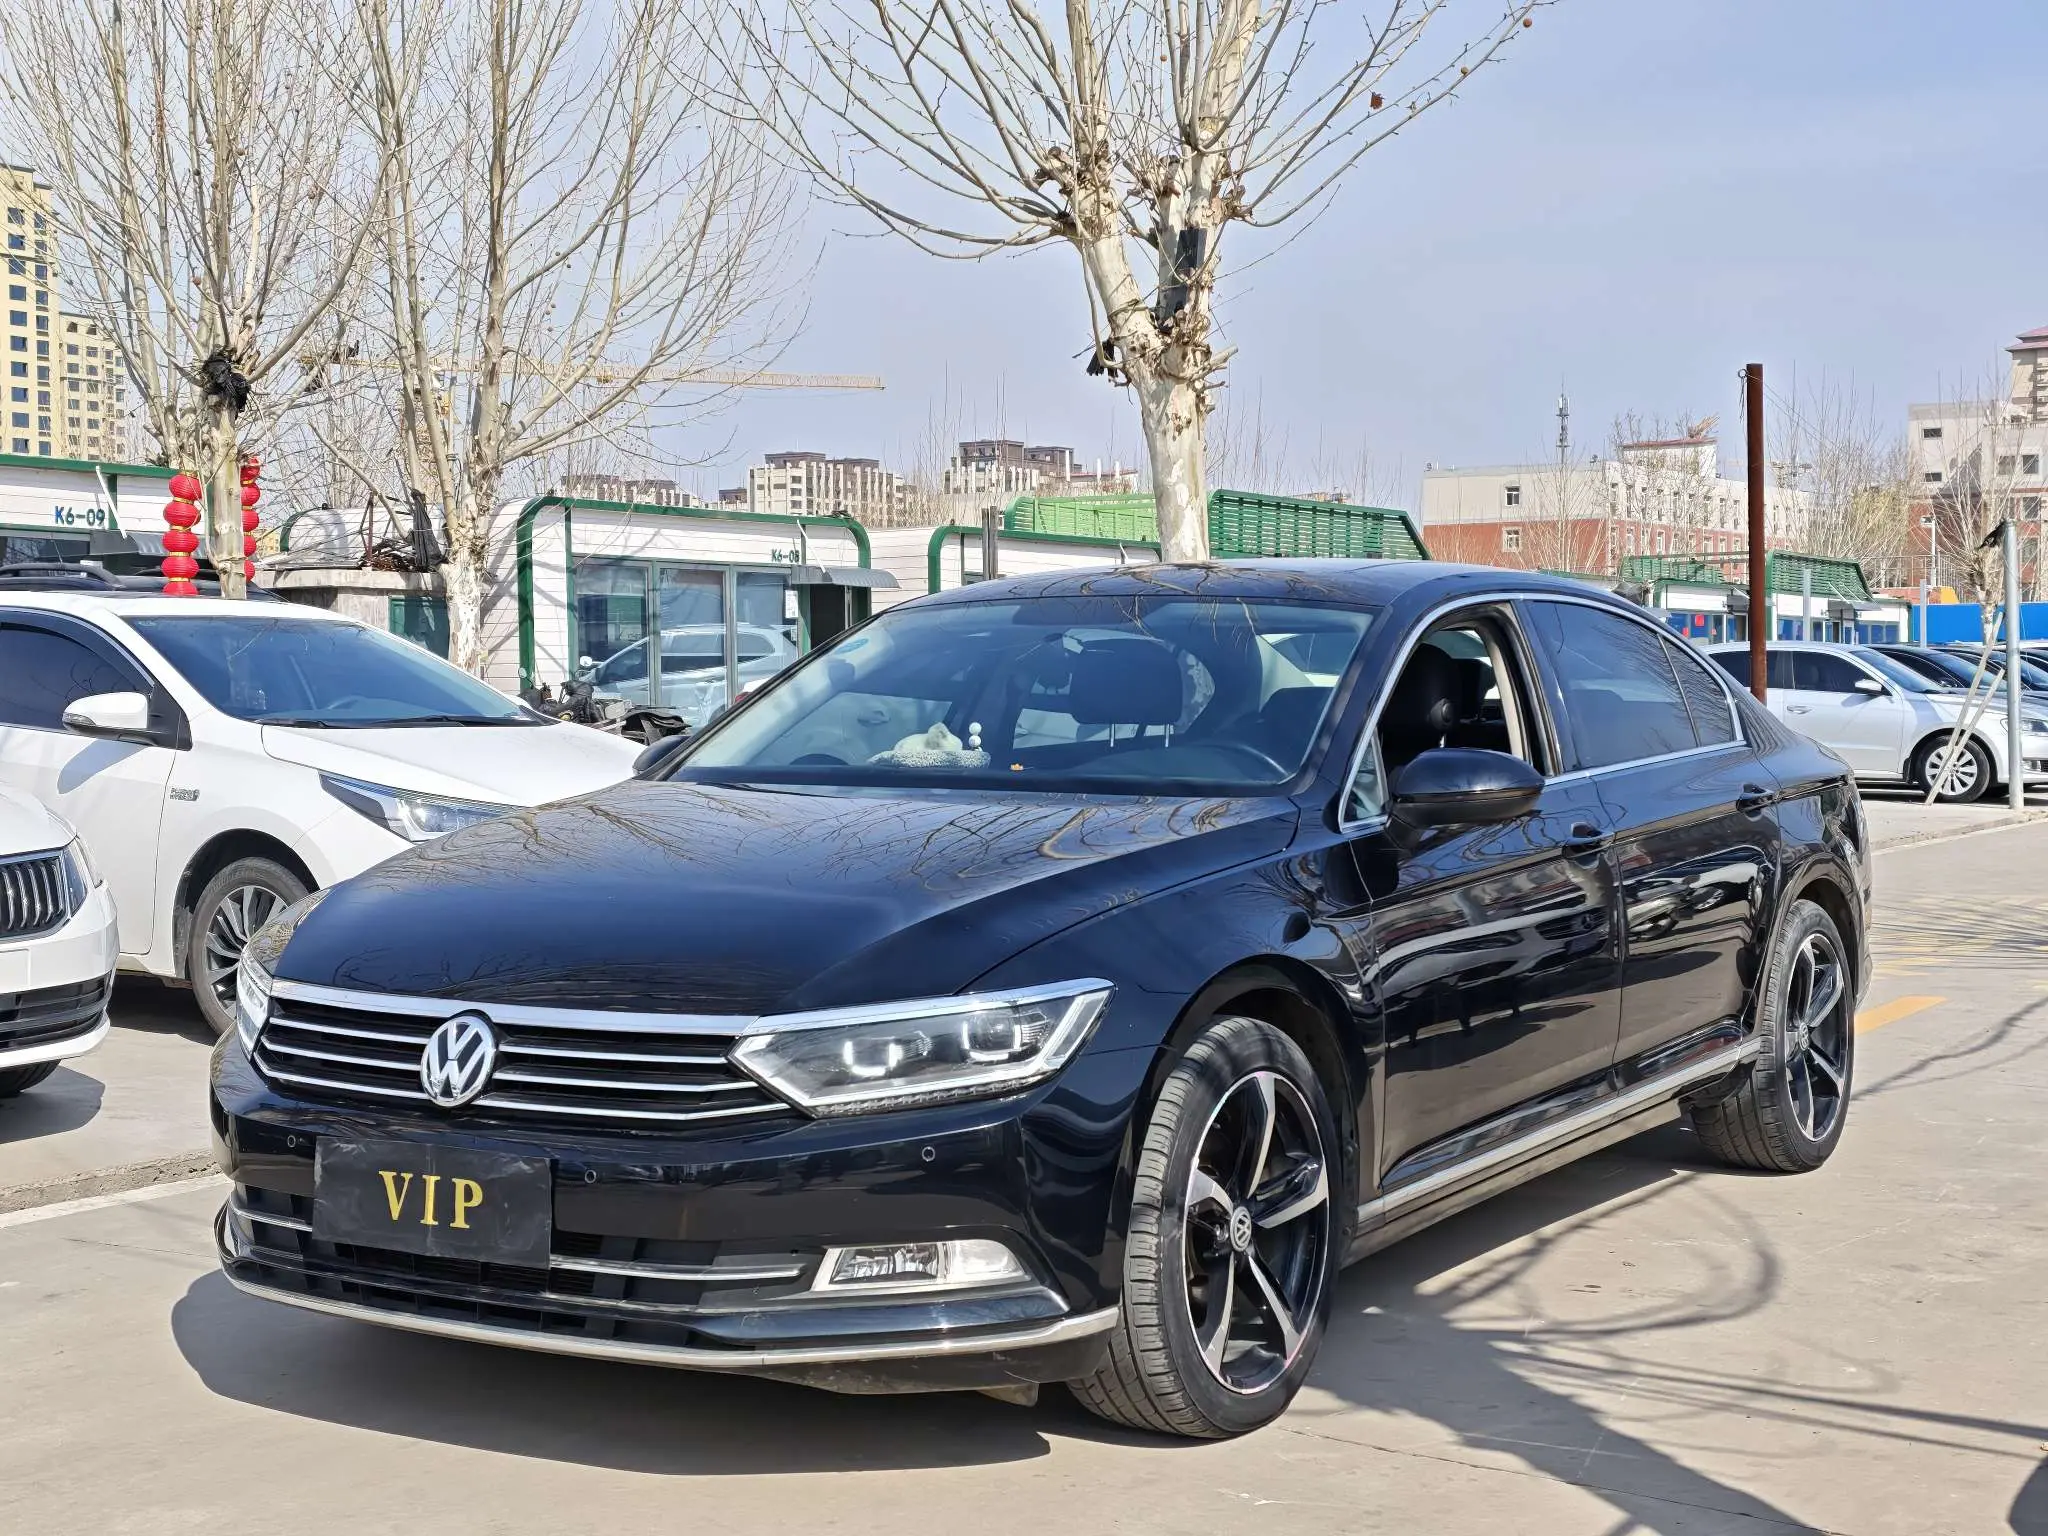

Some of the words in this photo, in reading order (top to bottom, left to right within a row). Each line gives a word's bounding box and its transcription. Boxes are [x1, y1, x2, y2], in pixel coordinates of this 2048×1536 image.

[55, 505, 106, 527] K6-09
[422, 1017, 494, 1106] VW
[378, 1170, 483, 1229] VIP
